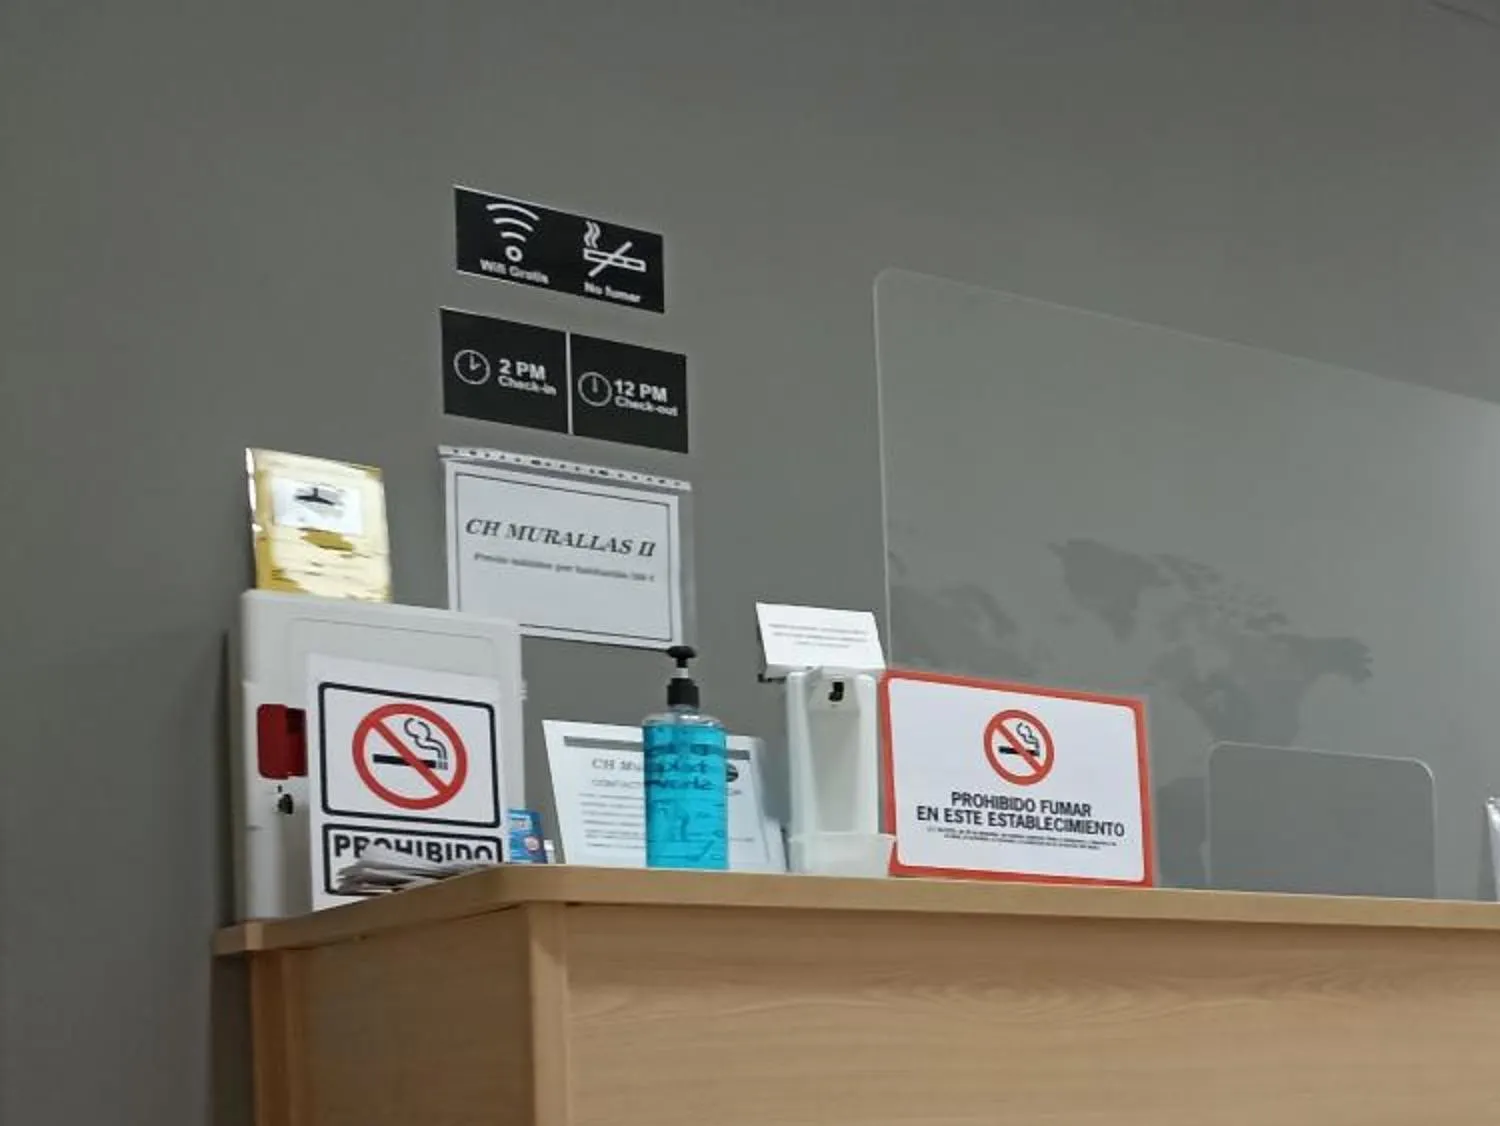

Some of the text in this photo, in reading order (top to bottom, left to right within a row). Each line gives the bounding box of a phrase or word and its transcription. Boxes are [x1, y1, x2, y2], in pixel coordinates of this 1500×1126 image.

[584, 281, 603, 296] No
[499, 359, 546, 381] 2 PM
[498, 375, 557, 397] Check-in
[613, 379, 668, 402] 12 PM
[614, 397, 679, 417] Check-out
[465, 518, 656, 557] CH MURALLAS II
[951, 791, 1092, 817] PROHIBIDO FUMAR
[917, 806, 939, 822] EN
[944, 809, 983, 826] ESTE
[987, 811, 1126, 838] ESTABLECIMIENTO
